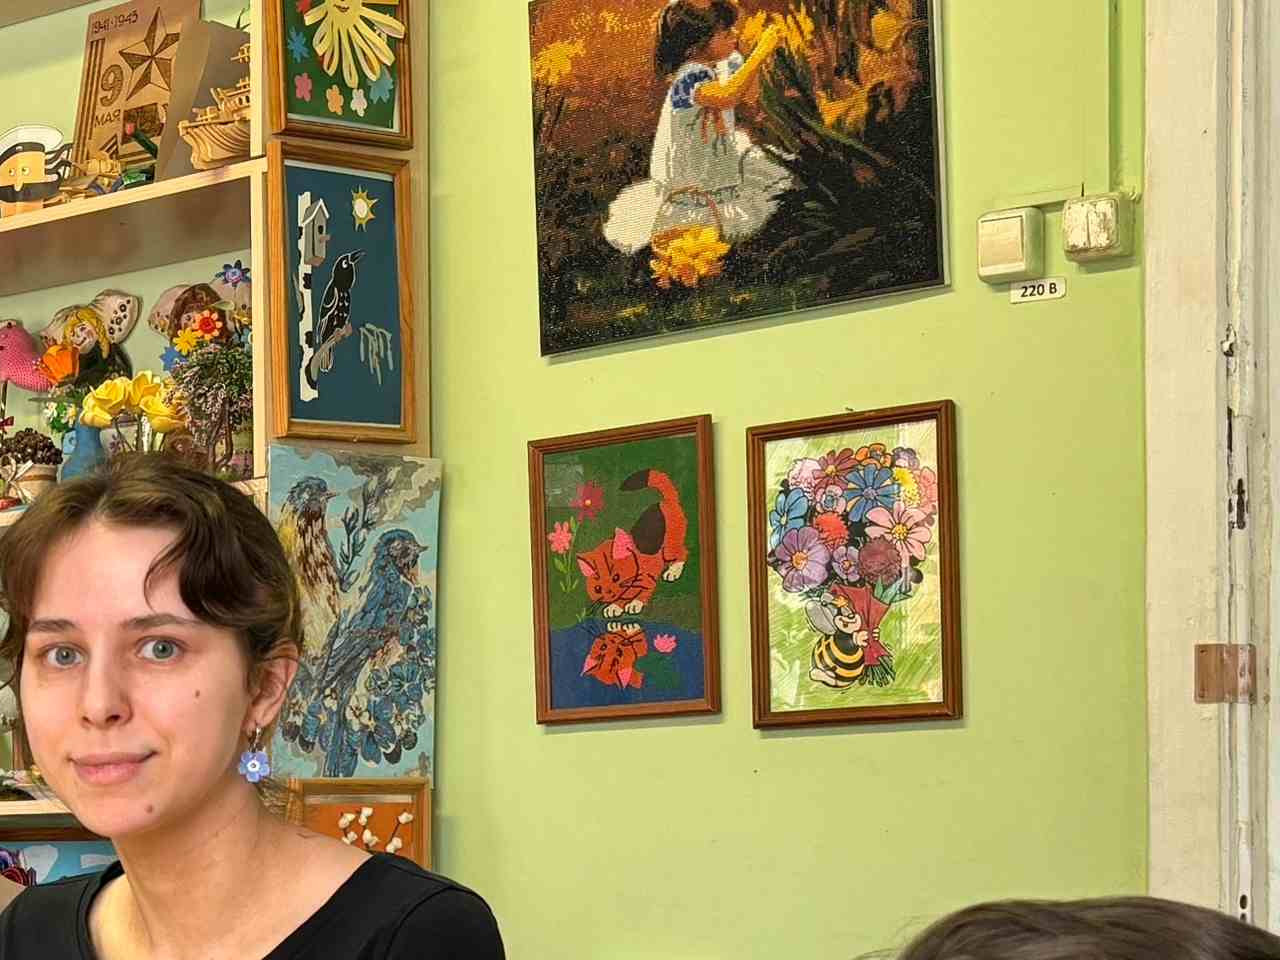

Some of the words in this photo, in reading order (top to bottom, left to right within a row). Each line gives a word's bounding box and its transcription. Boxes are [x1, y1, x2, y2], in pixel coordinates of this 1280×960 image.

[100, 64, 124, 107] 9
[94, 108, 121, 128] МАЯ
[1021, 284, 1045, 297] 220
[1049, 283, 1057, 294] В
